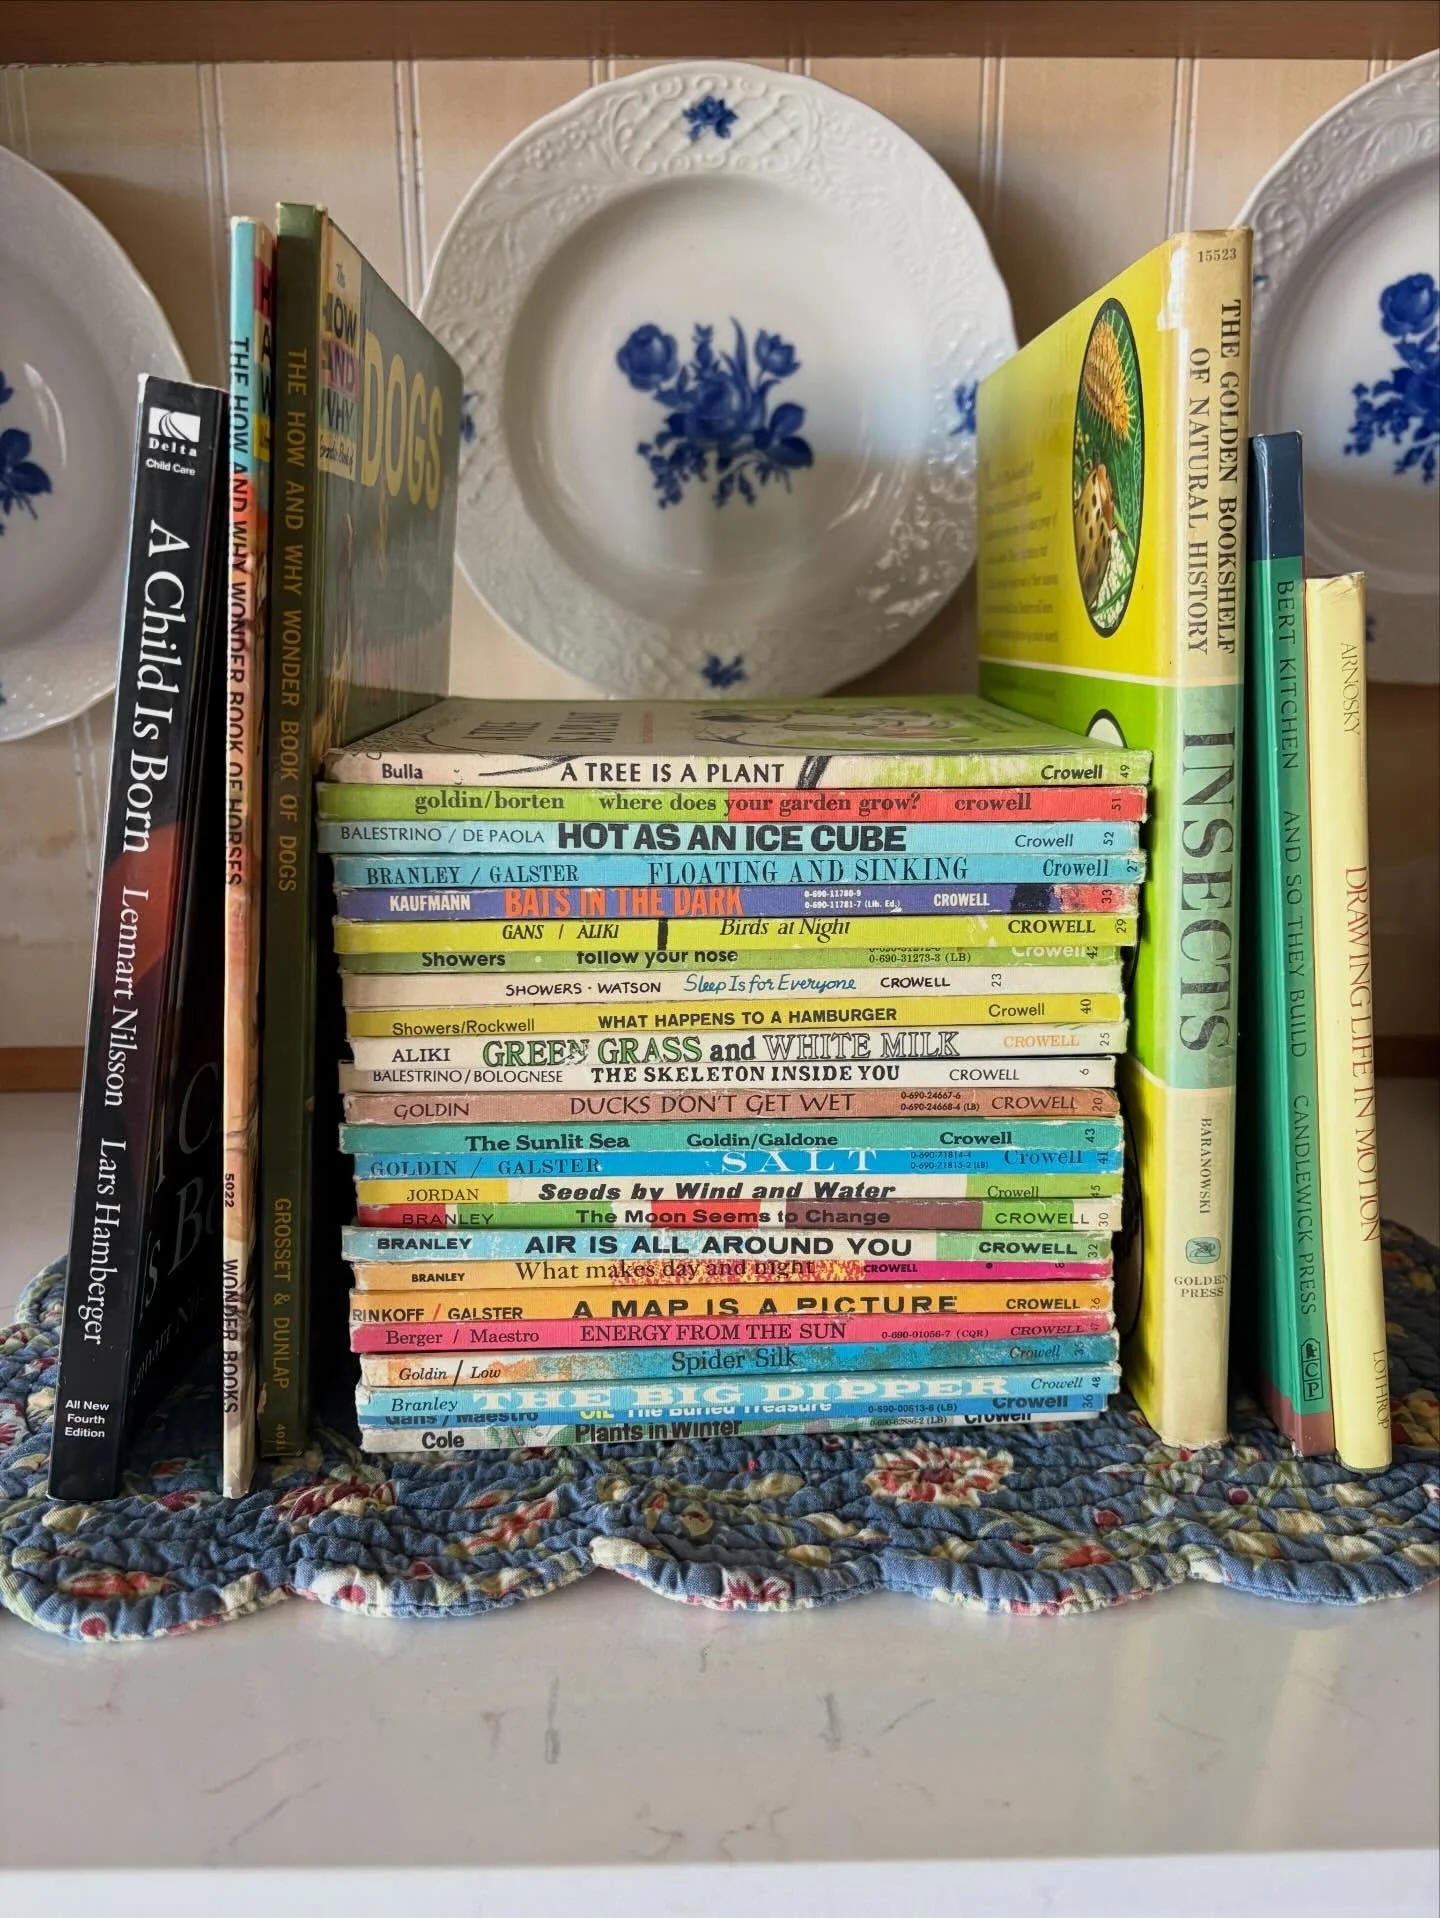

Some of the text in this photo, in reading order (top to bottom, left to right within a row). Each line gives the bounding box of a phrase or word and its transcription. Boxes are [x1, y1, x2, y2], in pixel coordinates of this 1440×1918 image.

[1198, 248, 1237, 263] 15523
[361, 329, 443, 511] DOGS
[148, 438, 198, 458] Delta
[145, 458, 197, 476] Child Care
[1215, 298, 1241, 655] THE GOLDEN BOOKSHELF
[1186, 347, 1211, 655] OF NATURAL HISTORY
[278, 348, 307, 893] THE HOW AND WHY WONDER BOOK OF DOGS
[1276, 580, 1299, 769] BERT KITCHEN
[121, 518, 191, 854] A Child Is Born
[1340, 642, 1361, 736] ARNOSKY
[382, 763, 423, 779] Bulla
[561, 762, 785, 783] A TREE IS A PLANT
[1041, 764, 1103, 780] Crowell
[1119, 764, 1130, 779] 49
[415, 790, 564, 814] goldin/borten
[599, 791, 921, 817] where does your garden grow?
[341, 826, 545, 843] BALESTRINO DE PAOLA
[557, 822, 907, 852] HOT AS AN ICE CUBE
[1103, 831, 1115, 846] 52
[365, 864, 580, 885] BRANLEY GALSTER
[647, 856, 969, 885] FLOATING AND SINKING
[933, 892, 990, 907] CROWELL
[1179, 728, 1235, 1052] INSECTS
[389, 894, 471, 912] KAUFMANN
[504, 887, 744, 918] BATS IN THE DARK
[720, 918, 850, 944] Birds at Night
[1282, 810, 1307, 1058] AND SO THEY BUILD
[868, 952, 972, 964] 0-690-31273-3 (LB)
[505, 981, 662, 997] SHOWERS WATSON
[880, 976, 951, 989] CROWELL
[103, 886, 149, 1108] Lennart Nilsson
[1080, 998, 1092, 1014] 40
[392, 1018, 535, 1036] Showers/Rockwell
[598, 1008, 897, 1029] WHAT HAPPENS TO A HAMBURGER
[482, 1031, 961, 1067] GREEN GRASS and WHITE MILK
[1003, 1034, 1080, 1048] CROWELL
[391, 1048, 451, 1062] ALIKI
[1345, 866, 1381, 1243] DRAWING LIFE IN MOTION
[591, 1064, 900, 1082] THE SKELETON INSIDE YOU
[571, 1093, 856, 1115] DUCKS DON'T GET WET
[900, 1091, 961, 1100] 0-690-24667-6
[394, 1103, 469, 1120] GOLDIN
[900, 1103, 980, 1112] 0-690-24668-4 (LB)
[465, 1132, 630, 1152] The Sunlit Sea
[686, 1132, 839, 1148] Goldin/Galdone
[1199, 1117, 1213, 1214] BARANOWSKI
[224, 1173, 235, 1209] 5022
[406, 1188, 479, 1202] JORDAN
[1293, 1094, 1318, 1316] CANDLEWICK PRESS
[402, 1213, 494, 1225] BRANLEY
[575, 1209, 891, 1226] The Moon Seems to Change
[77, 1138, 126, 1345] Lars Hamberger
[377, 1237, 473, 1250] BRANLEY
[524, 1235, 912, 1256] AIR IS ALL AROUND YOU
[978, 1240, 1078, 1255] CROWELL
[863, 1263, 918, 1273] CROWELL
[1174, 1274, 1230, 1287] GOLDEN
[1180, 1287, 1225, 1298] PRESS
[385, 1328, 540, 1347] Berger Maestro
[579, 1322, 848, 1342] ENERGY FROM THE SUN
[671, 1346, 798, 1375] Spider Silk
[472, 1375, 1010, 1410] THE BIG DIPPER
[1372, 1348, 1392, 1430] LOTHROP
[65, 1398, 110, 1412] All New
[391, 1397, 458, 1412] Branley
[67, 1412, 106, 1426] Fourth
[64, 1426, 106, 1438] Edition
[421, 1430, 465, 1449] Cole
